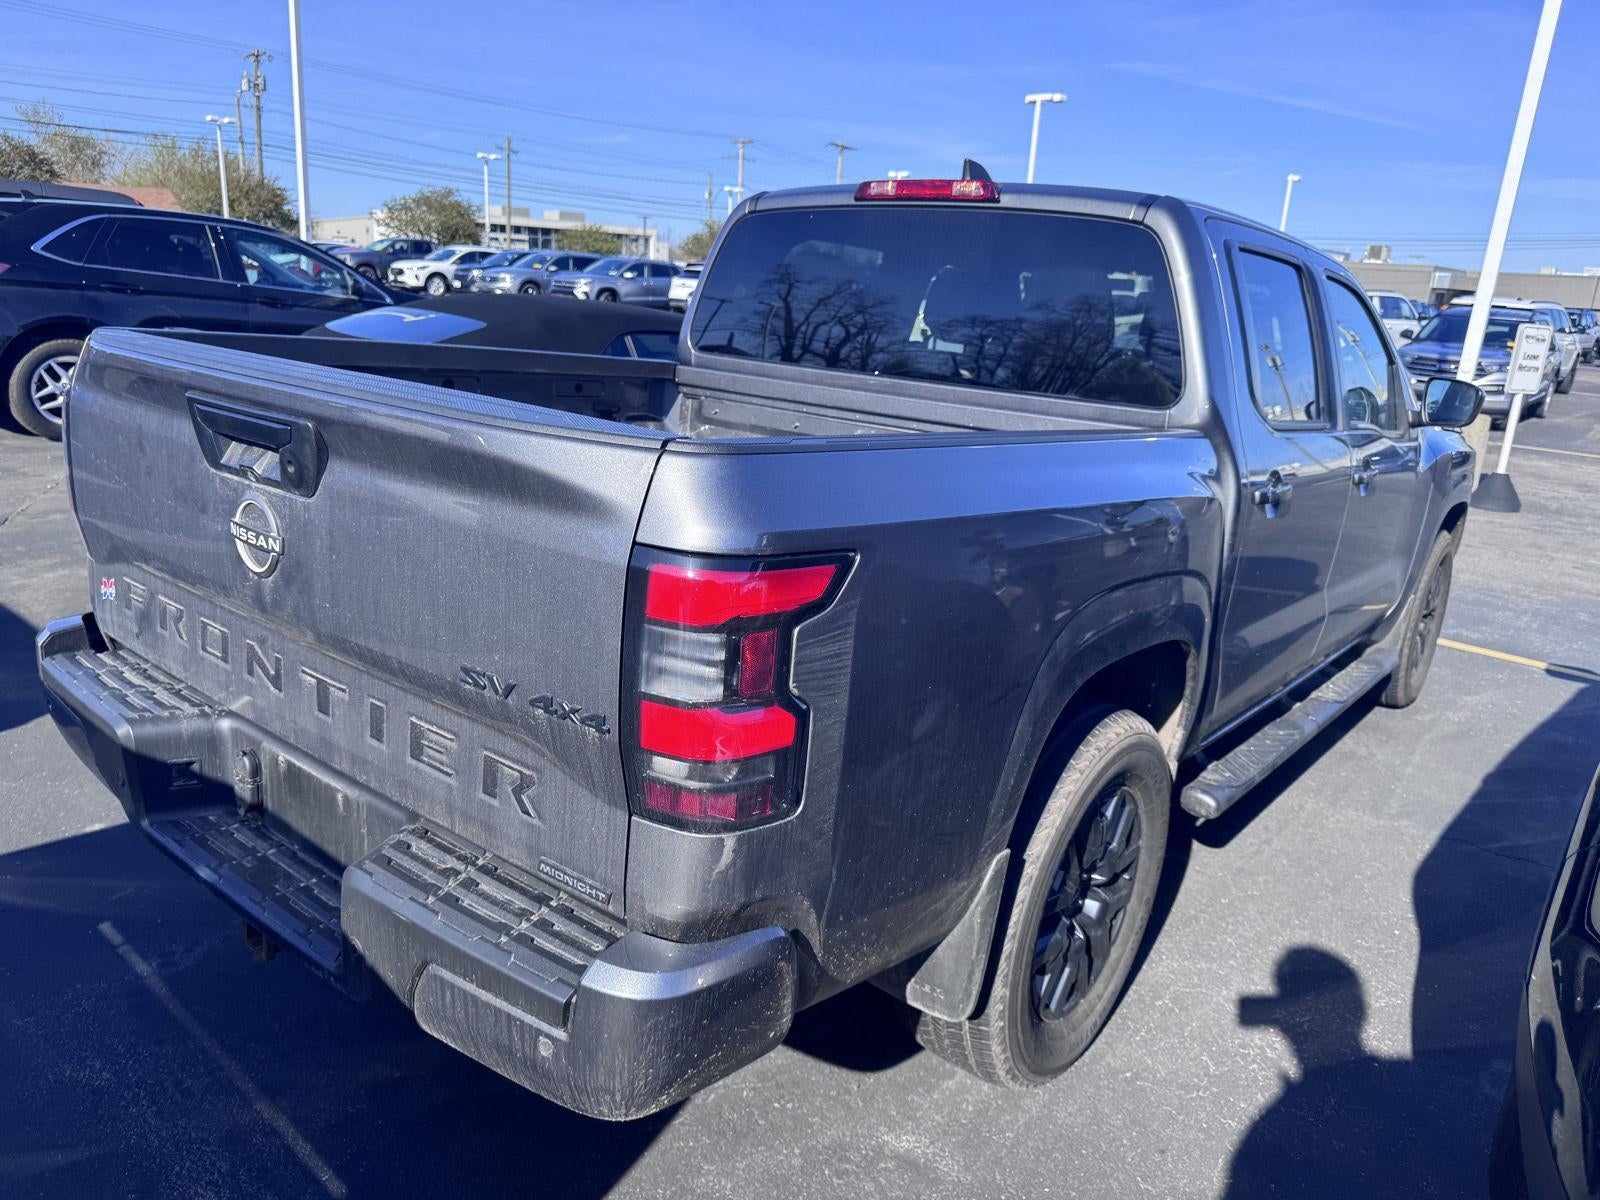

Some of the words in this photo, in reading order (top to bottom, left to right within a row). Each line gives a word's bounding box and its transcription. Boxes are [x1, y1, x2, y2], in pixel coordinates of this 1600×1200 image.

[1522, 351, 1540, 361] Lease
[229, 521, 280, 553] NISSAN
[122, 576, 539, 820] FRONTIER
[459, 663, 517, 700] SV
[539, 862, 606, 901] MIDNIGHT
